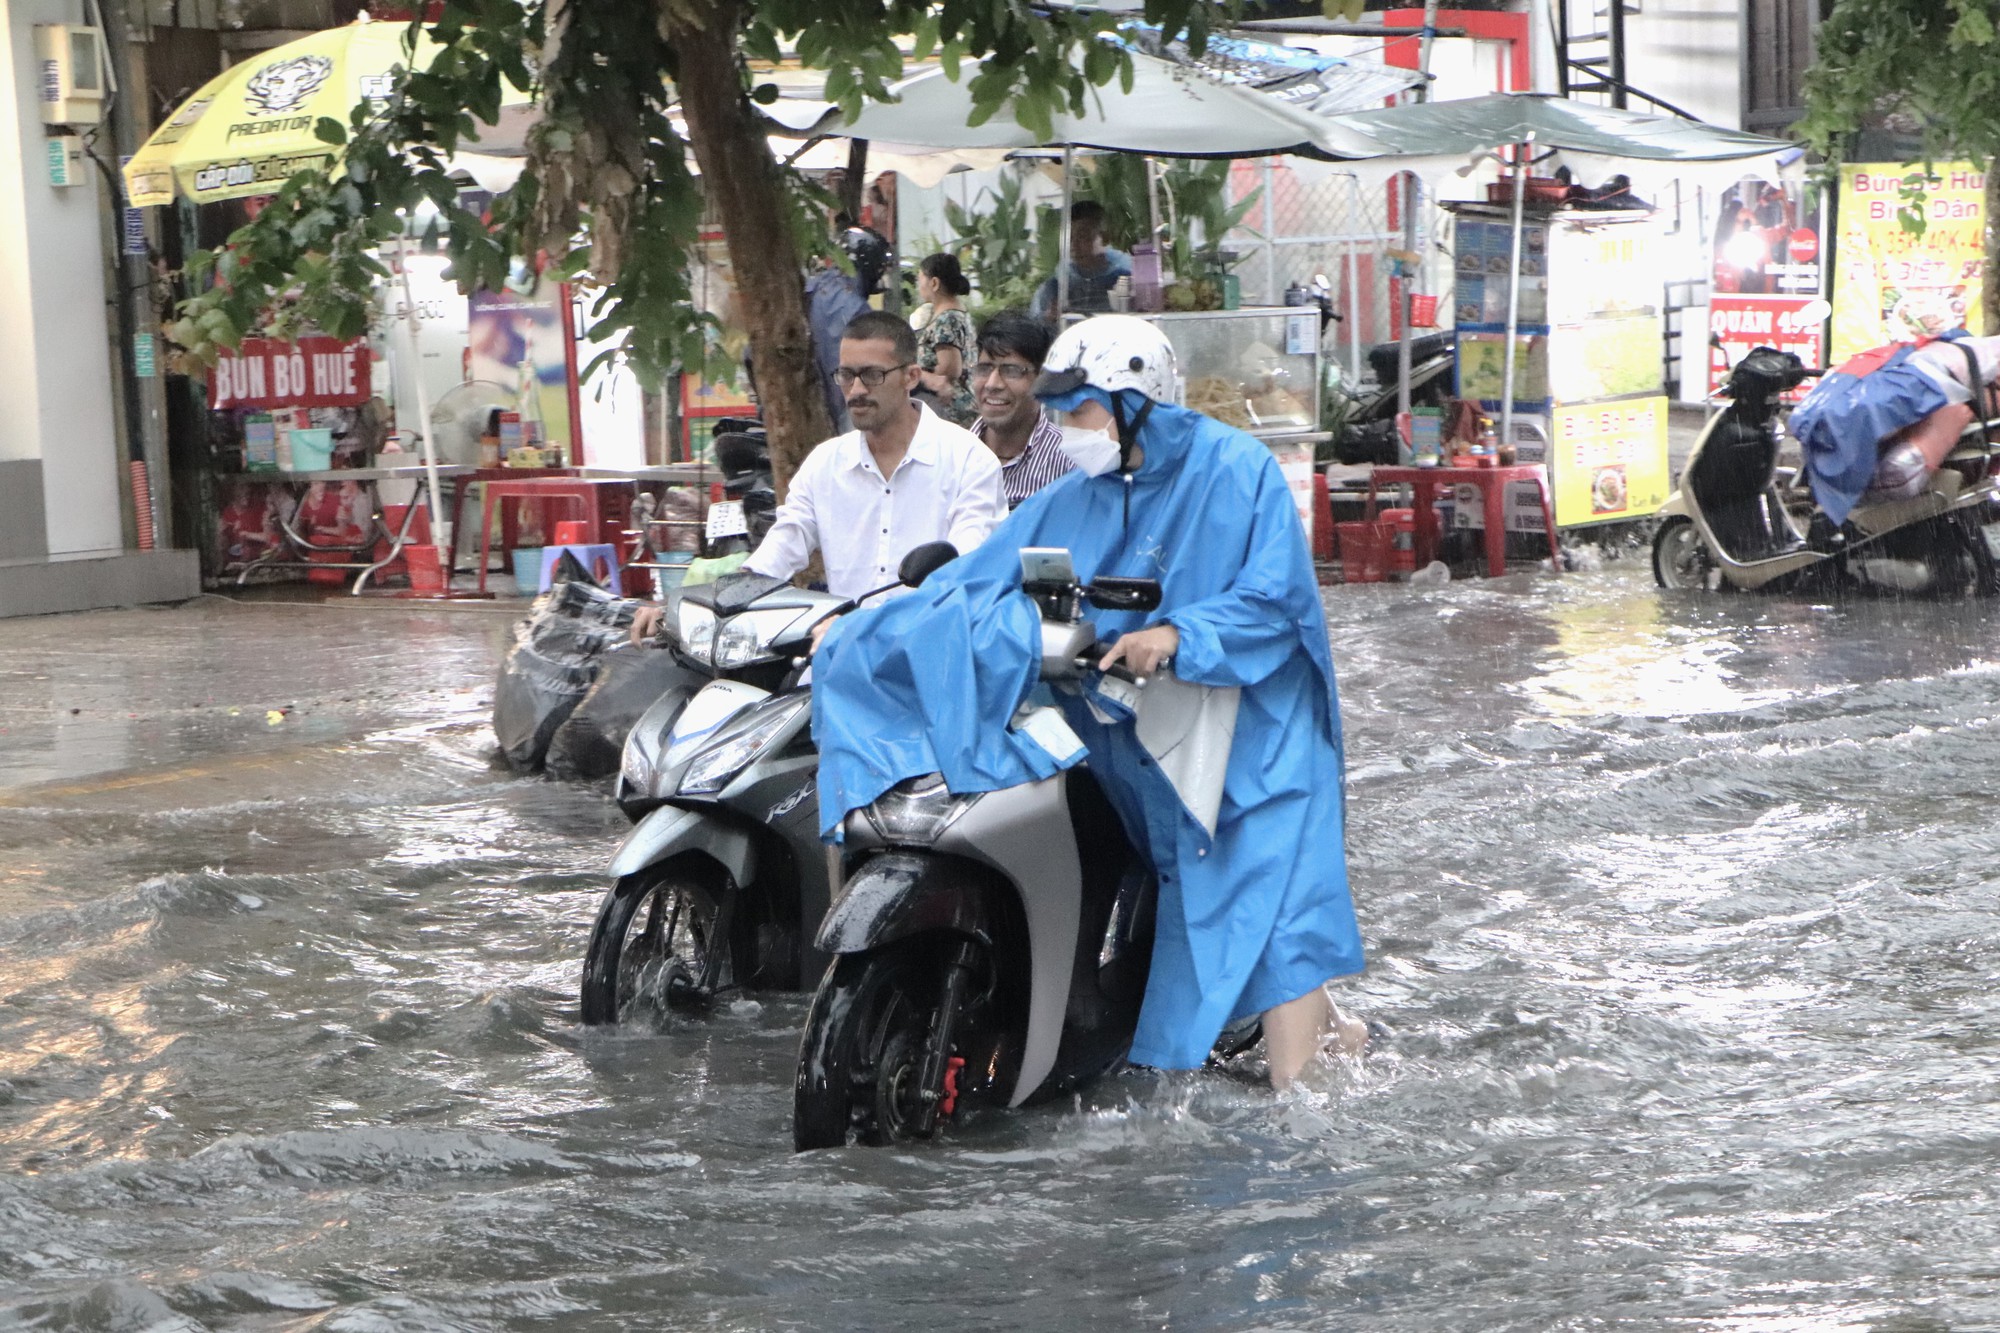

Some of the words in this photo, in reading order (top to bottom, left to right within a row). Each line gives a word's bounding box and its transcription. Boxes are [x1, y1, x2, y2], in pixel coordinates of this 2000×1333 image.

[226, 115, 313, 143] PREDATOR
[1933, 199, 1979, 218] Dân
[1711, 305, 1774, 338] QUÁN
